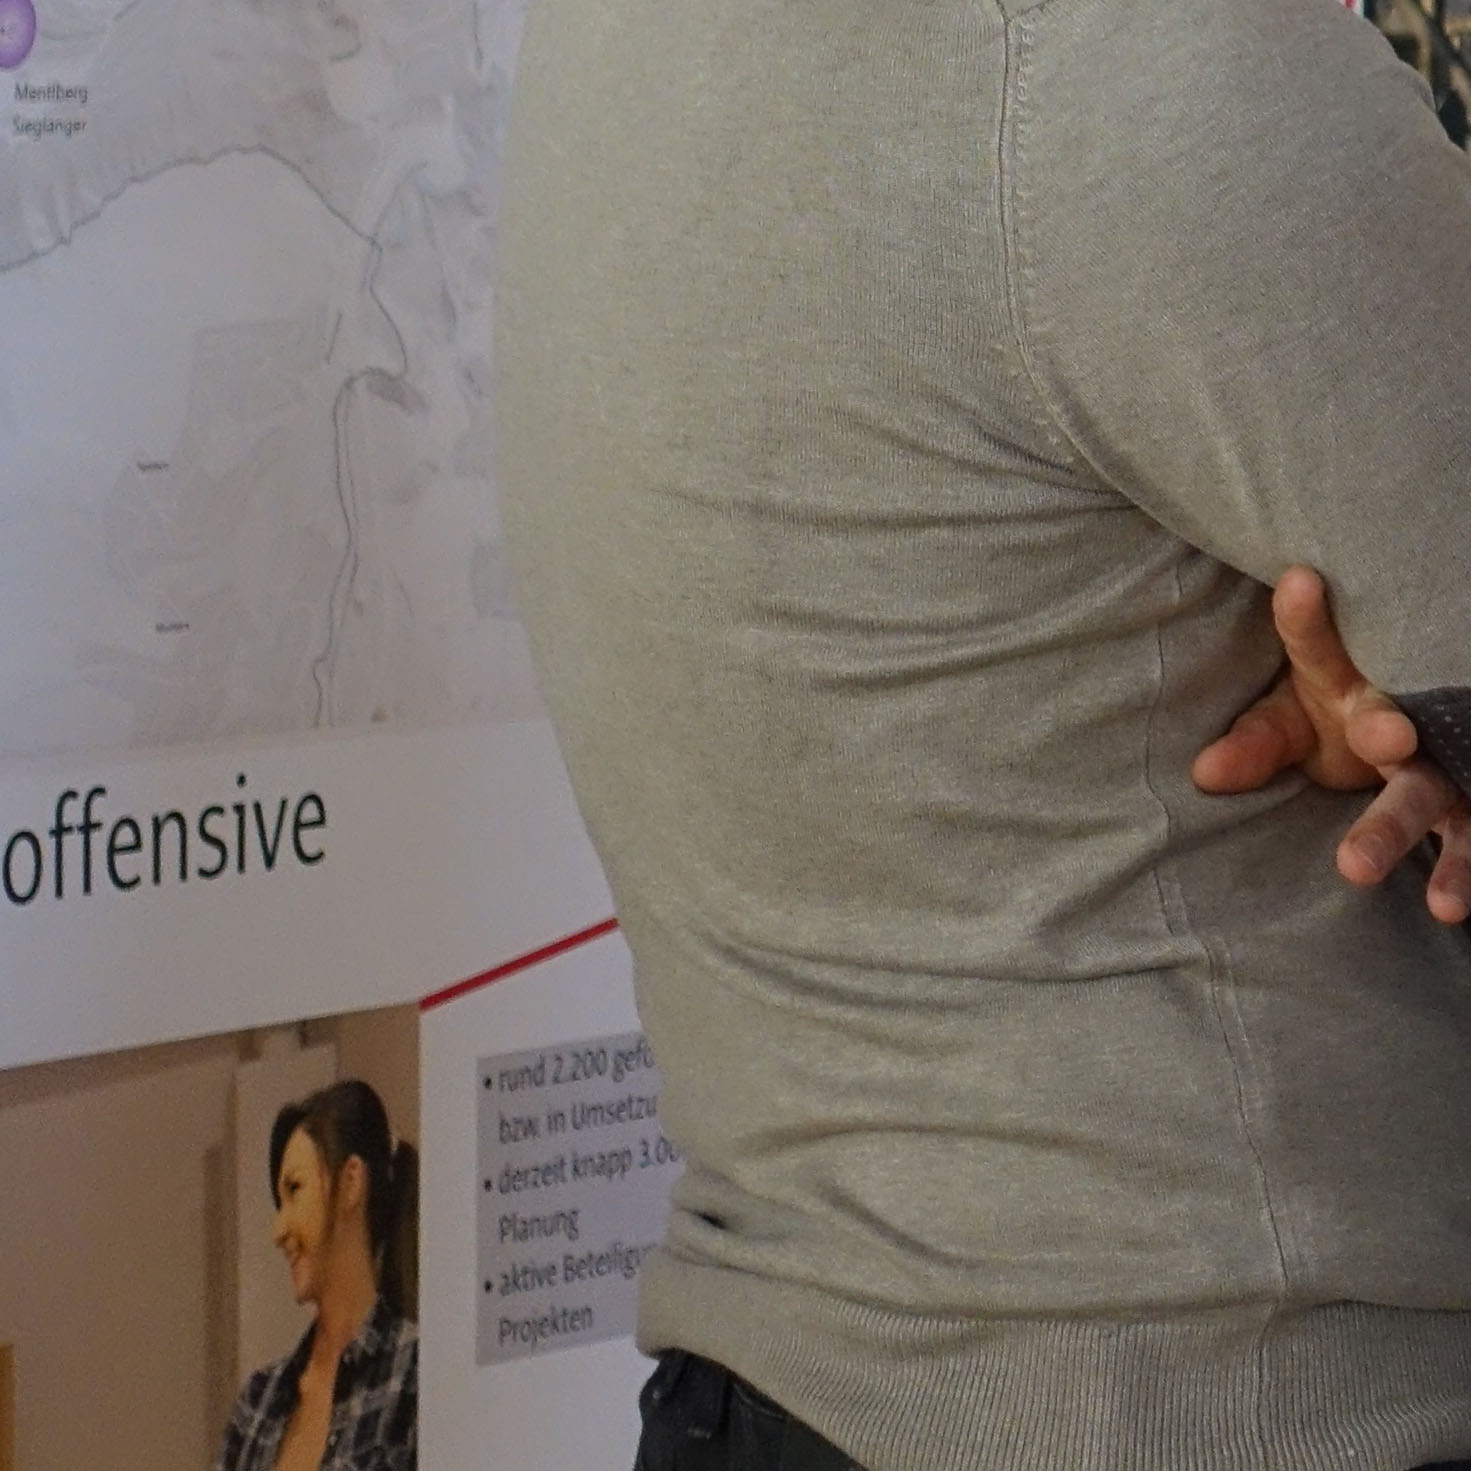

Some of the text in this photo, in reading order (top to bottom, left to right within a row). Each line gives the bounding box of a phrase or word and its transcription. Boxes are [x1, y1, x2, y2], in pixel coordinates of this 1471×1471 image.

[3, 772, 327, 906] offensive
[500, 1054, 546, 1093] rund
[552, 1047, 608, 1085] 2.200
[547, 1110, 565, 1134] in
[500, 1154, 567, 1195] derzeit
[572, 1146, 632, 1183] knapp
[500, 1209, 580, 1245] Planung
[500, 1261, 557, 1297] aktive
[500, 1305, 594, 1351] Projekten
